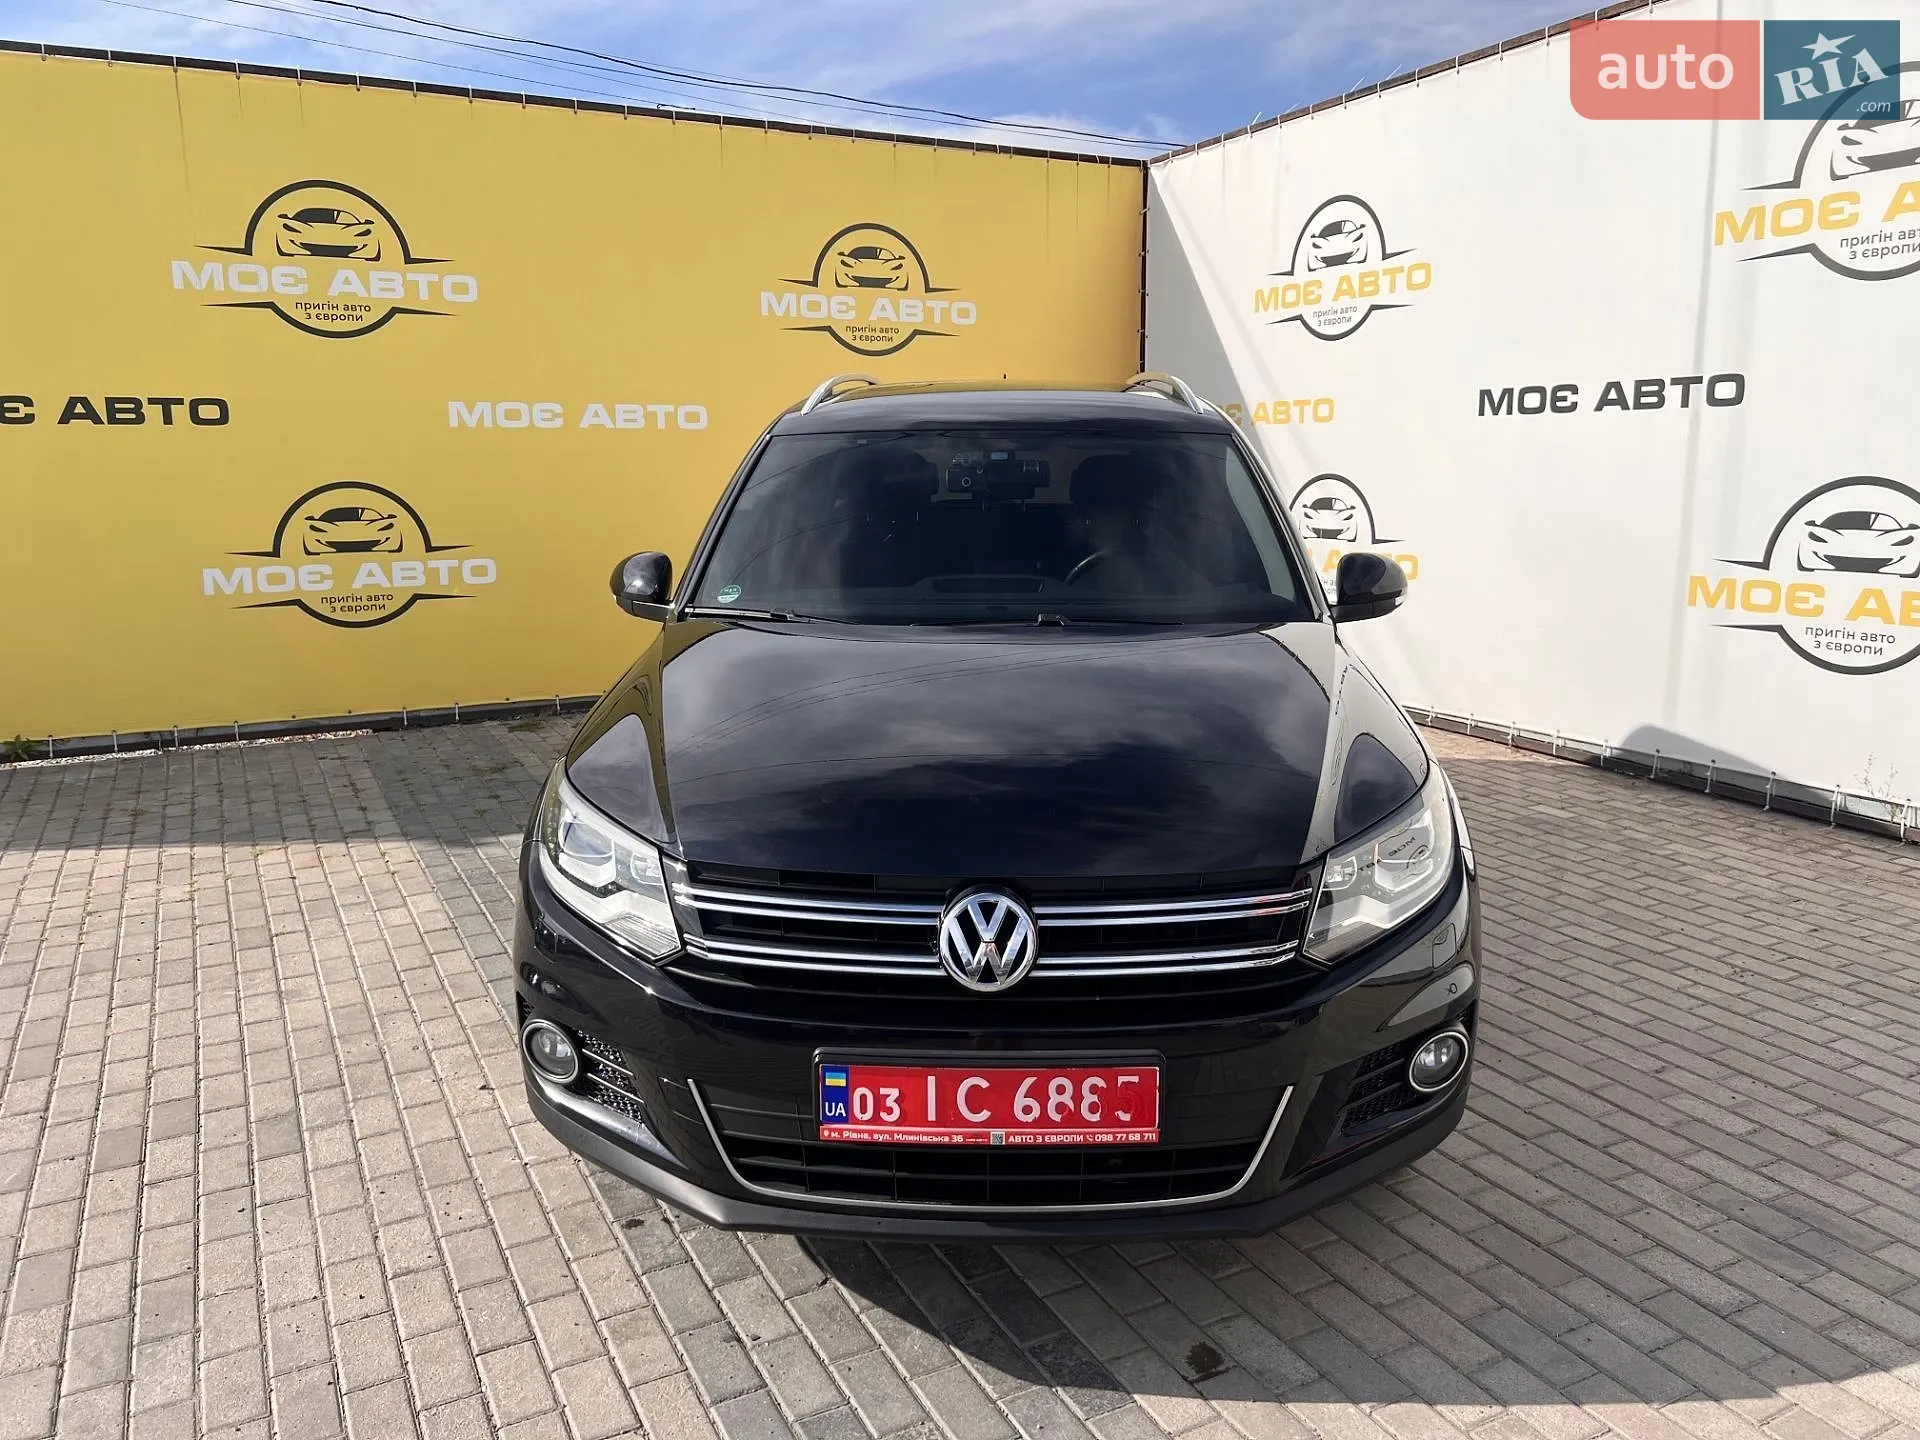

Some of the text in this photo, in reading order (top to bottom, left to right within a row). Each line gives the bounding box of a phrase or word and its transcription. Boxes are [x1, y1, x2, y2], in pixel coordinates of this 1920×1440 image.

[1714, 191, 1861, 246] МОЄ
[1839, 230, 1893, 249] пригін
[1861, 242, 1920, 260] європи
[171, 260, 478, 303] МОЄ АВТО
[1254, 262, 1432, 313] МОЄ АВТО
[295, 301, 372, 313] пригін авто
[760, 291, 977, 325] МОЄ АВТО
[315, 313, 364, 323] європи
[845, 324, 900, 334] пригін авто
[859, 334, 893, 343] європи
[1478, 373, 1746, 416] МОЄ АВТО
[57, 396, 230, 426] АВТО
[448, 401, 709, 430] МОЄ АВТО
[1251, 398, 1334, 426] АВТО
[202, 558, 497, 596] МОЄ АВТО
[321, 593, 394, 605] пригін авто
[1687, 575, 1826, 617] МОЄ
[340, 604, 386, 614] європи
[1805, 626, 1896, 644] пригін авто
[1825, 641, 1883, 656] європи
[825, 1102, 847, 1117] UA
[853, 1087, 901, 1122] 03
[894, 1133, 949, 1143] Млинівська
[1008, 1135, 1034, 1143] АВТО
[1044, 1134, 1084, 1143] ЄВРОПИ
[1095, 1134, 1113, 1142] 098
[1116, 1133, 1126, 1141] 77
[1143, 1132, 1156, 1141] 711
